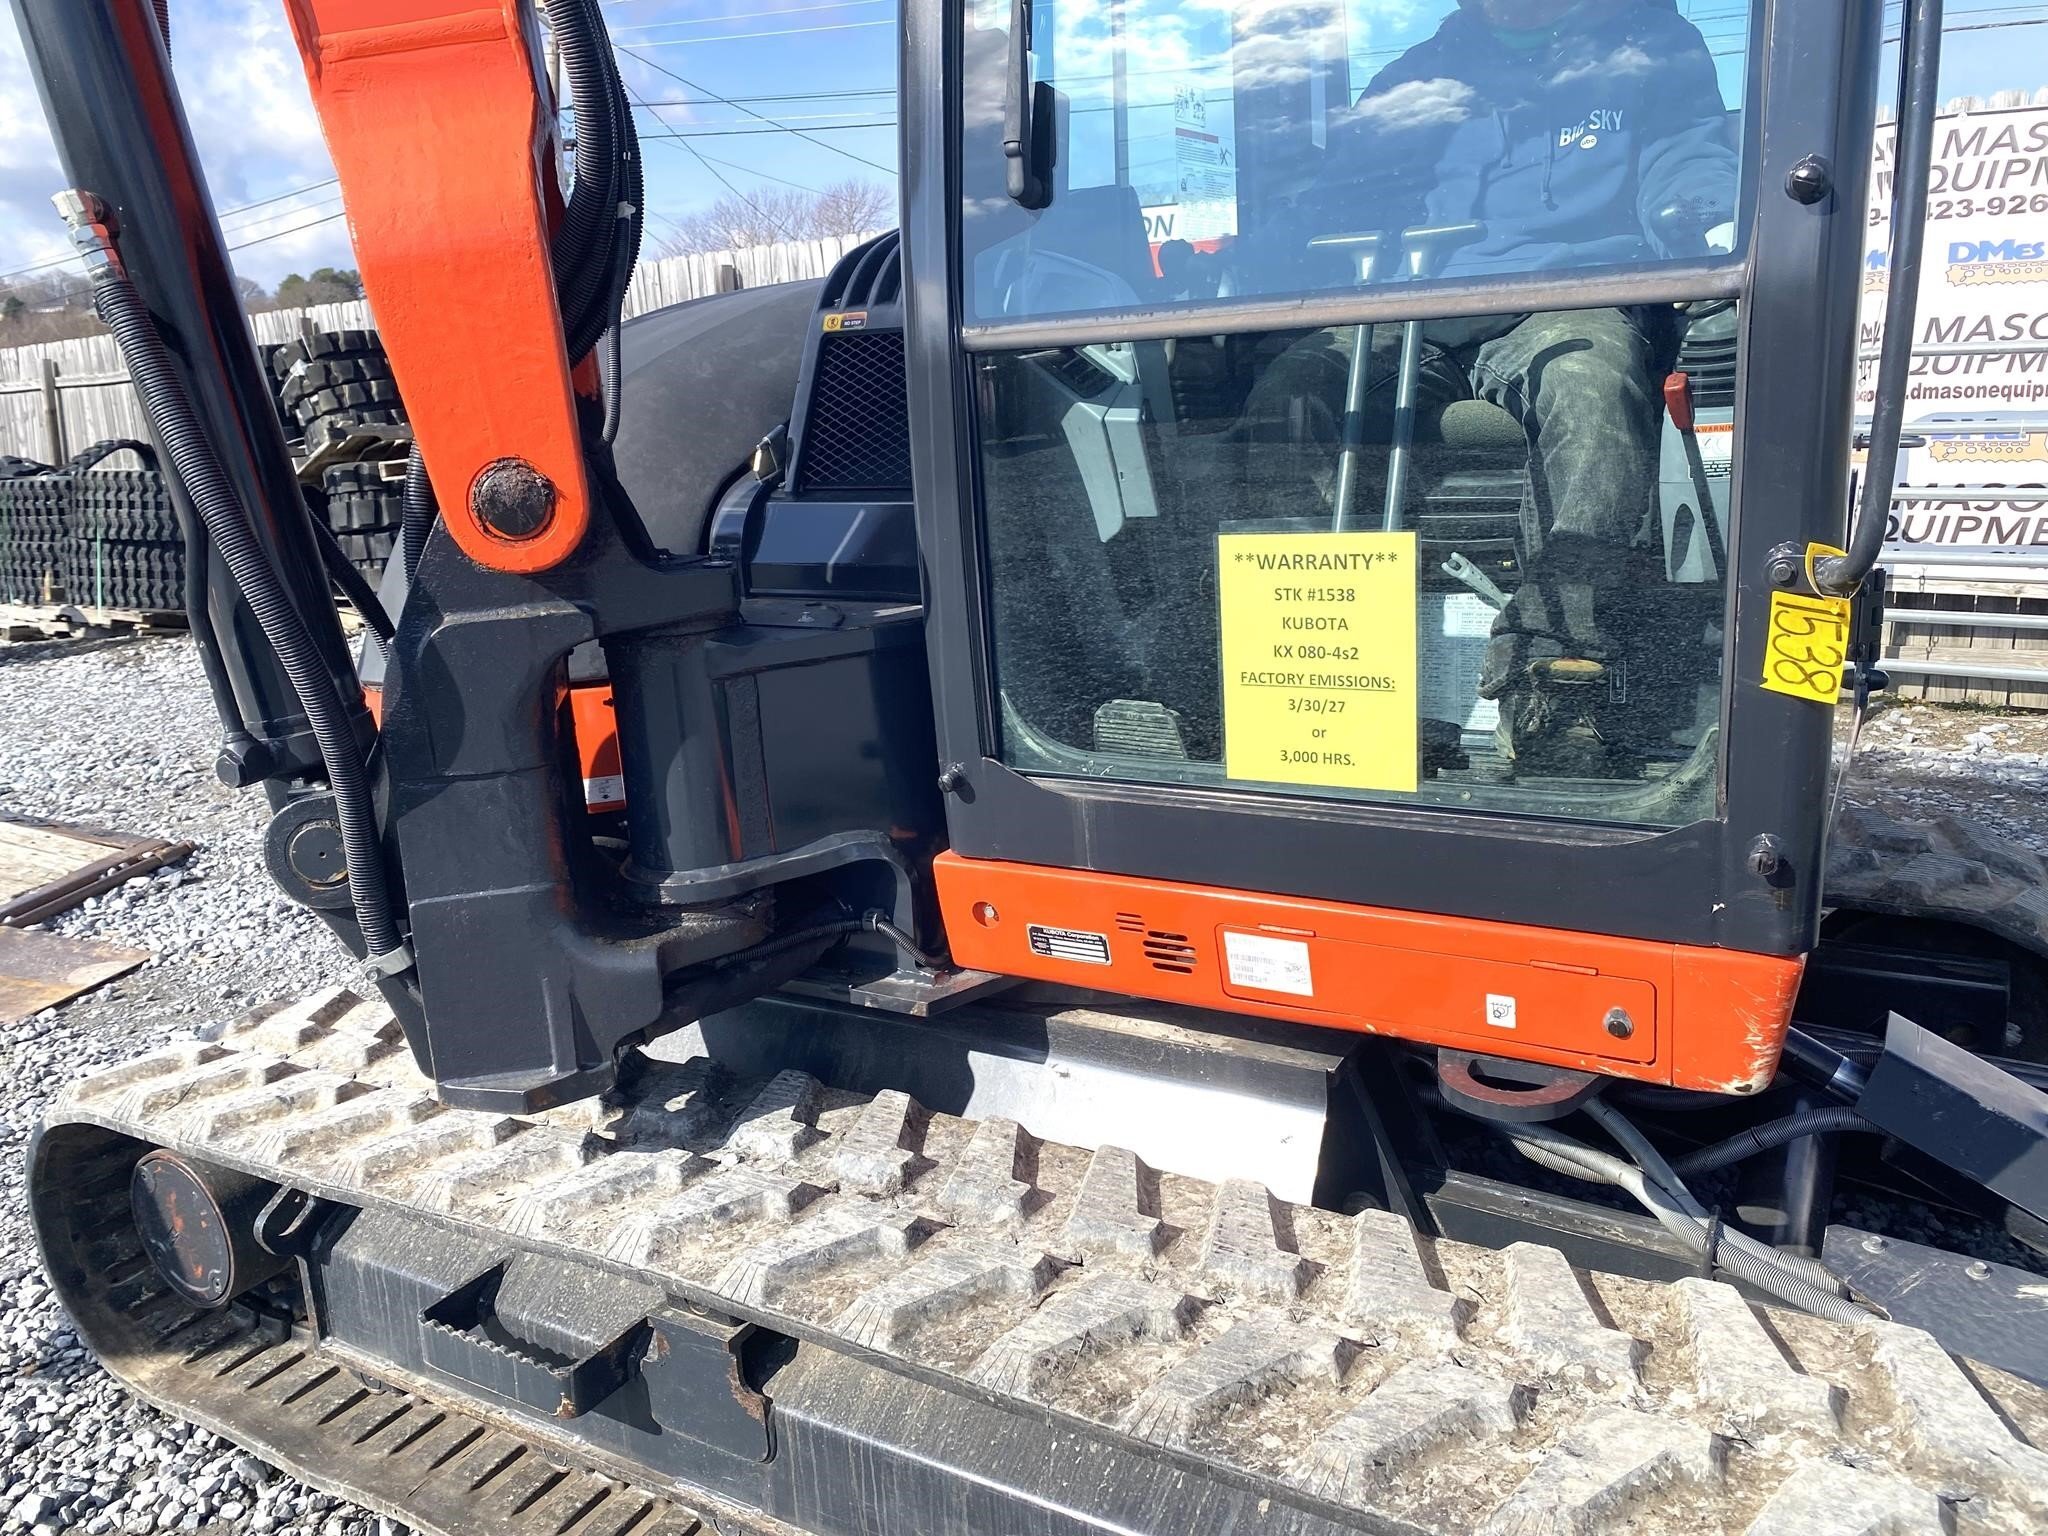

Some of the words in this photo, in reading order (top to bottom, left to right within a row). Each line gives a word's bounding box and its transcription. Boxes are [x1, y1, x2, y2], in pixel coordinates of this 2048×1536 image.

[1588, 109, 1623, 132] SKY
[1905, 380, 2048, 402] .dmasonequip
[1274, 588, 1302, 601] STK
[1307, 588, 1356, 602] #1538
[1282, 616, 1349, 631] KUBOTA
[1273, 645, 1293, 658] KX
[1298, 645, 1359, 660] 080-4s2
[1772, 601, 1844, 694] 1538
[1240, 671, 1304, 686] FACTORY
[1309, 674, 1396, 690] EMISSIONS:
[1288, 698, 1346, 714] 3/30/27
[1311, 728, 1327, 738] or
[1280, 749, 1318, 764] 3,000
[1322, 752, 1356, 767] HRS.
[1042, 928, 1067, 937] KUBOTA
